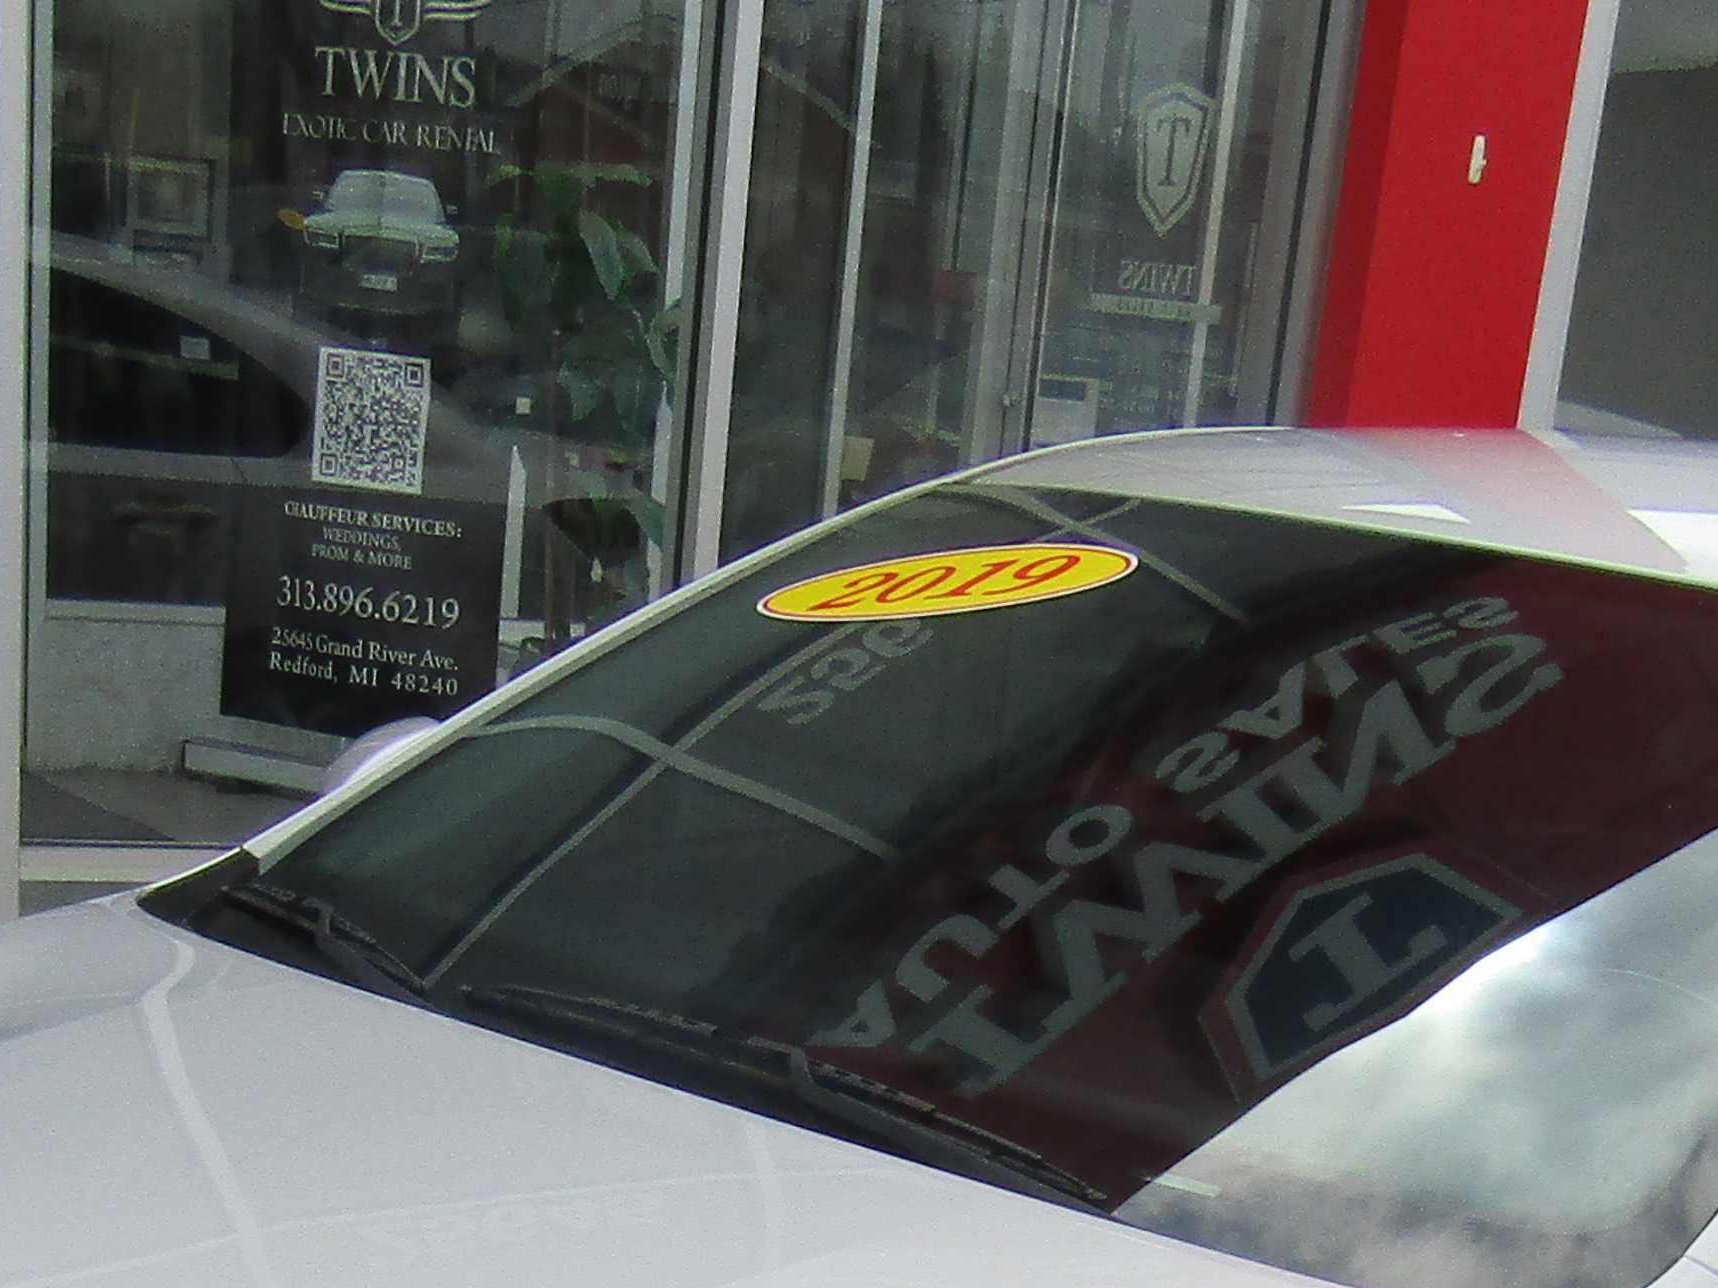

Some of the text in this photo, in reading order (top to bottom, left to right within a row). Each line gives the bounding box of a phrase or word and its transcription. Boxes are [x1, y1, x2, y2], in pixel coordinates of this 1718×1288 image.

[314, 46, 476, 107] TWINS
[363, 119, 408, 146] CAR
[416, 123, 501, 154] RENTAL
[284, 500, 463, 539] CHAUFFEUR SERVICES:
[311, 543, 412, 570] PROM & MORE
[276, 575, 461, 630] 313.896.6219
[805, 554, 1082, 612] 2019
[271, 626, 460, 672] 25645 Grand River Ave.
[268, 651, 459, 697] Redford, MI 48240
